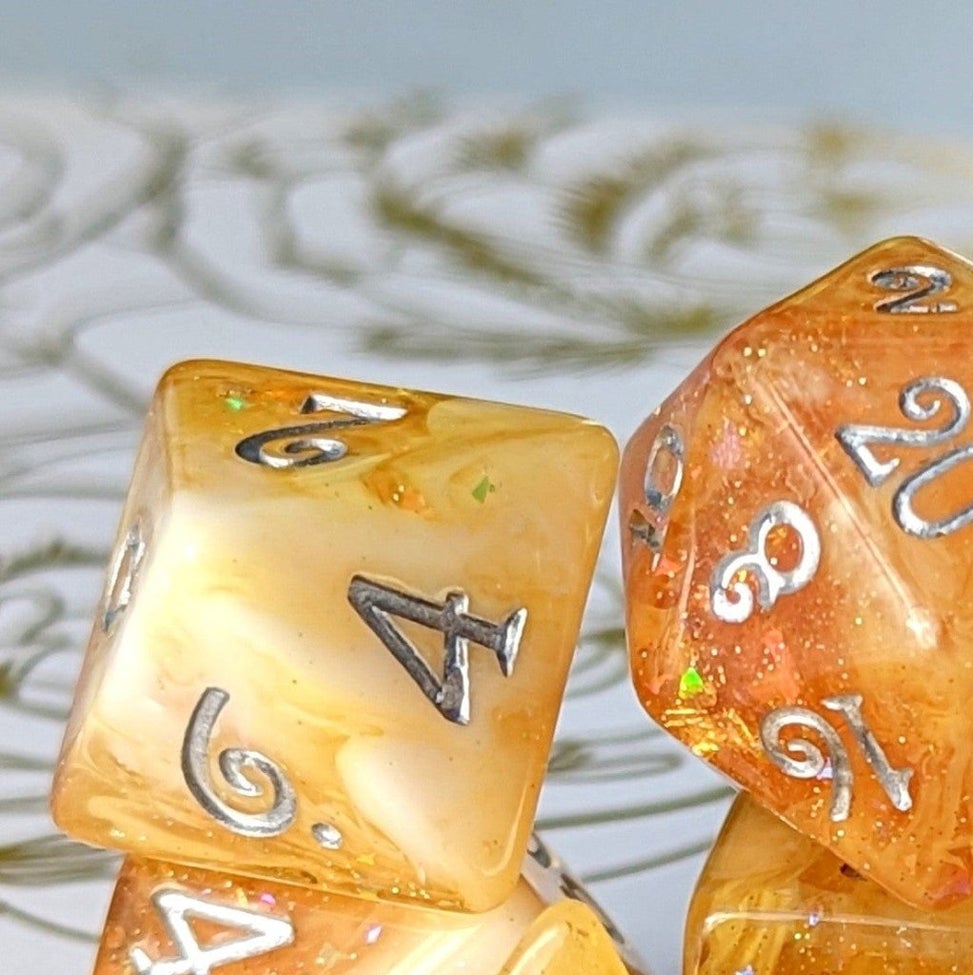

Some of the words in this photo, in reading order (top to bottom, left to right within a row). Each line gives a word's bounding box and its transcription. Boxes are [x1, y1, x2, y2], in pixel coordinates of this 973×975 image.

[868, 265, 959, 315] 2
[709, 500, 821, 624] 8
[347, 574, 528, 726] 4
[759, 693, 913, 822] 16
